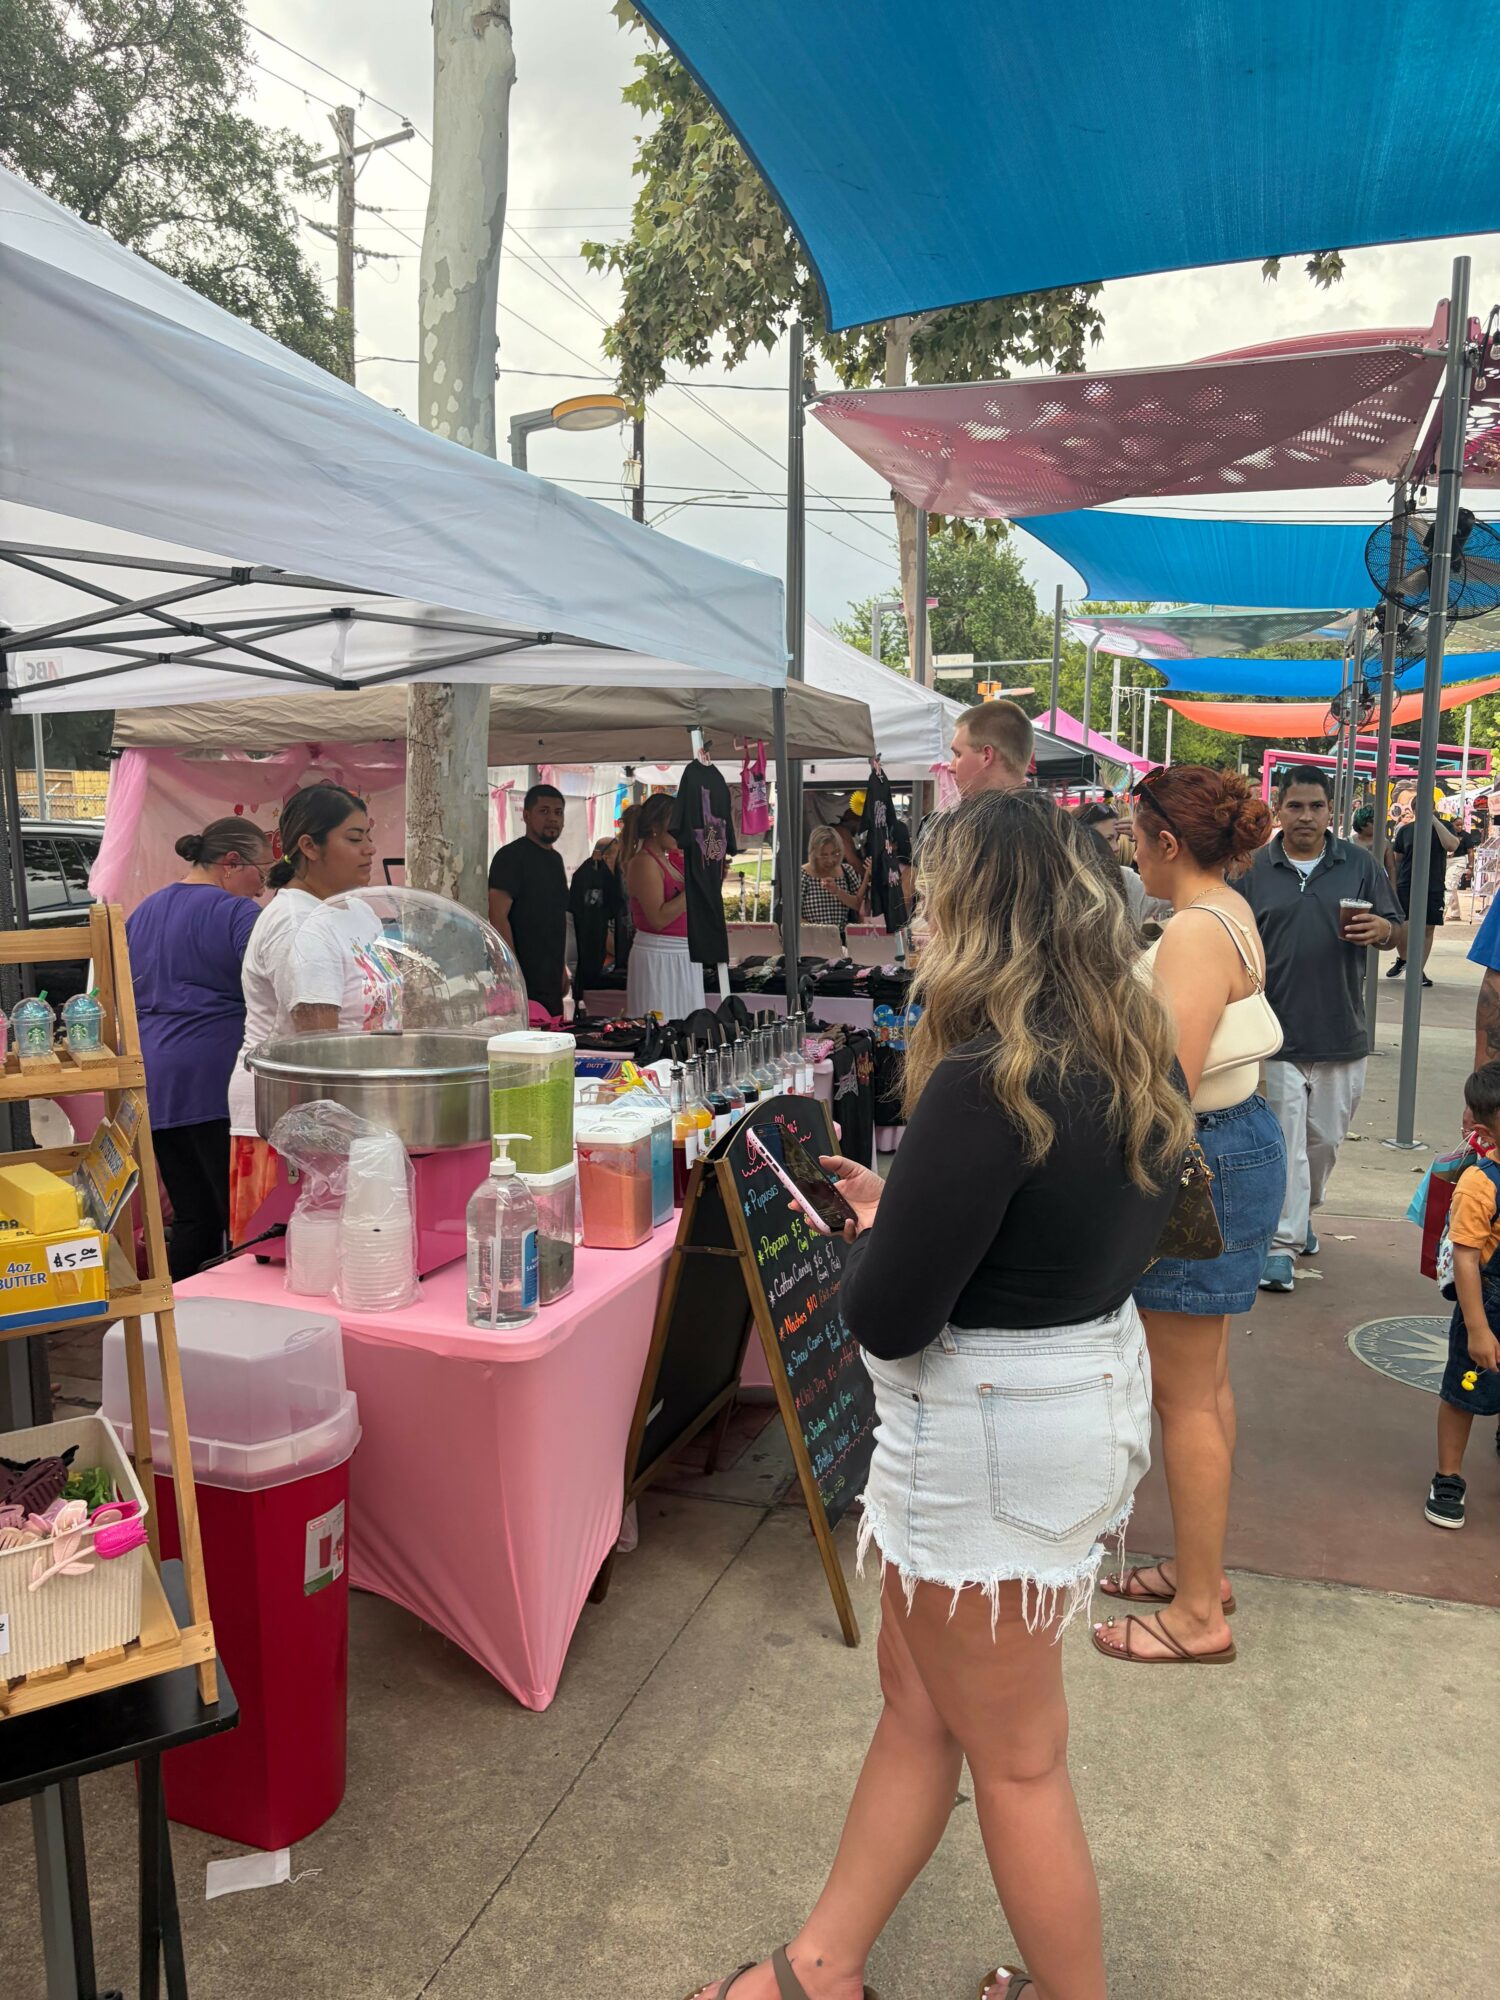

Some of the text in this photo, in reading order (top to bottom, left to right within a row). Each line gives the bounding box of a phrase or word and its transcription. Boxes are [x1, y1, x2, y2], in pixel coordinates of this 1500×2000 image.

[750, 1184, 779, 1214] Pupusas
[760, 1233, 789, 1261] Popcorn
[791, 1218, 802, 1239] $5
[773, 1241, 835, 1298] Cotton Candy $6 $7
[784, 1311, 808, 1335] Nachos
[806, 1294, 818, 1315] $10
[791, 1348, 809, 1369] Snow
[806, 1332, 824, 1351] Cones
[1360, 1319, 1446, 1354] MANAGEMENT
[1372, 1356, 1408, 1374] END
[808, 1417, 828, 1440] Sodas
